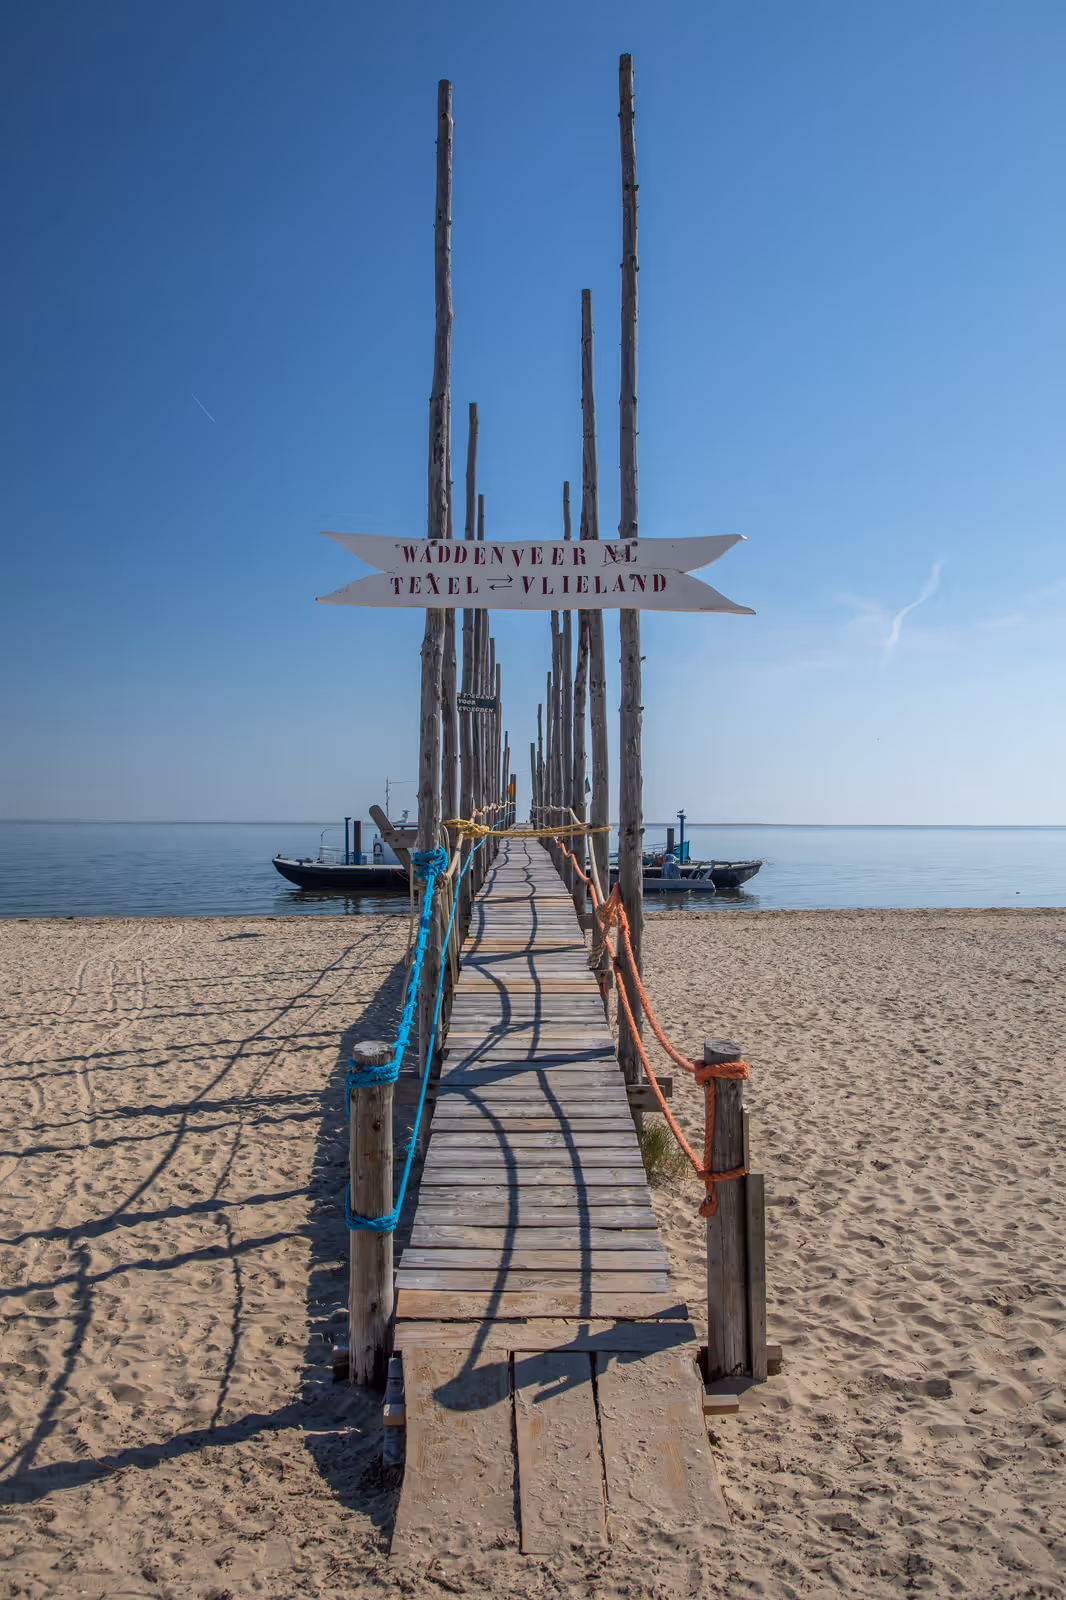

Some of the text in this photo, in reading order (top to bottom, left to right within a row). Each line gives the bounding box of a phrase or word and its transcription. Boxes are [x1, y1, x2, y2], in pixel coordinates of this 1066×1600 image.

[402, 544, 637, 567] WADDENVEER NL
[390, 573, 667, 595] TEXEL VLIELAND
